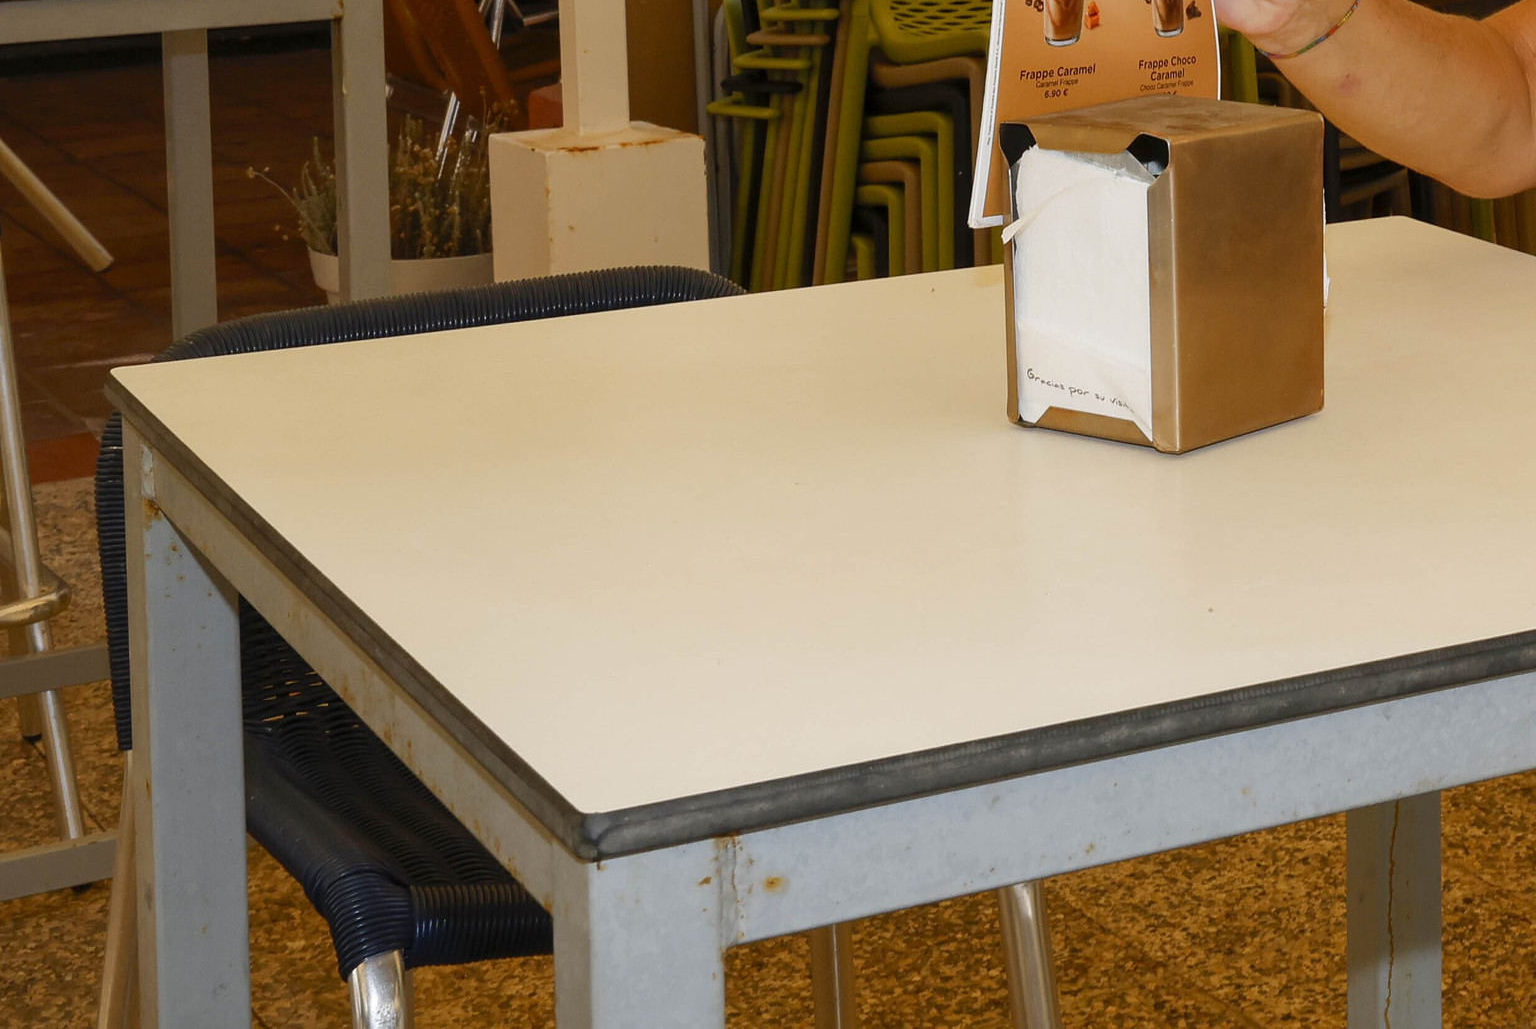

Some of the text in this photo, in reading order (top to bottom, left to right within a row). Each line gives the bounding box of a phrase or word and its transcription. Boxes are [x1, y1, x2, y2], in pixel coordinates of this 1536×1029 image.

[1138, 55, 1197, 71] Frappe Choco
[1019, 63, 1096, 81] Frappe Caramel
[1150, 68, 1185, 81] Caramel
[1035, 78, 1079, 88] Caramel Frappe
[1177, 79, 1194, 88] Frappe
[1044, 88, 1068, 99] 6.90 €
[1026, 368, 1065, 391] Gracias
[1068, 386, 1090, 397] por
[1094, 393, 1106, 401] su
